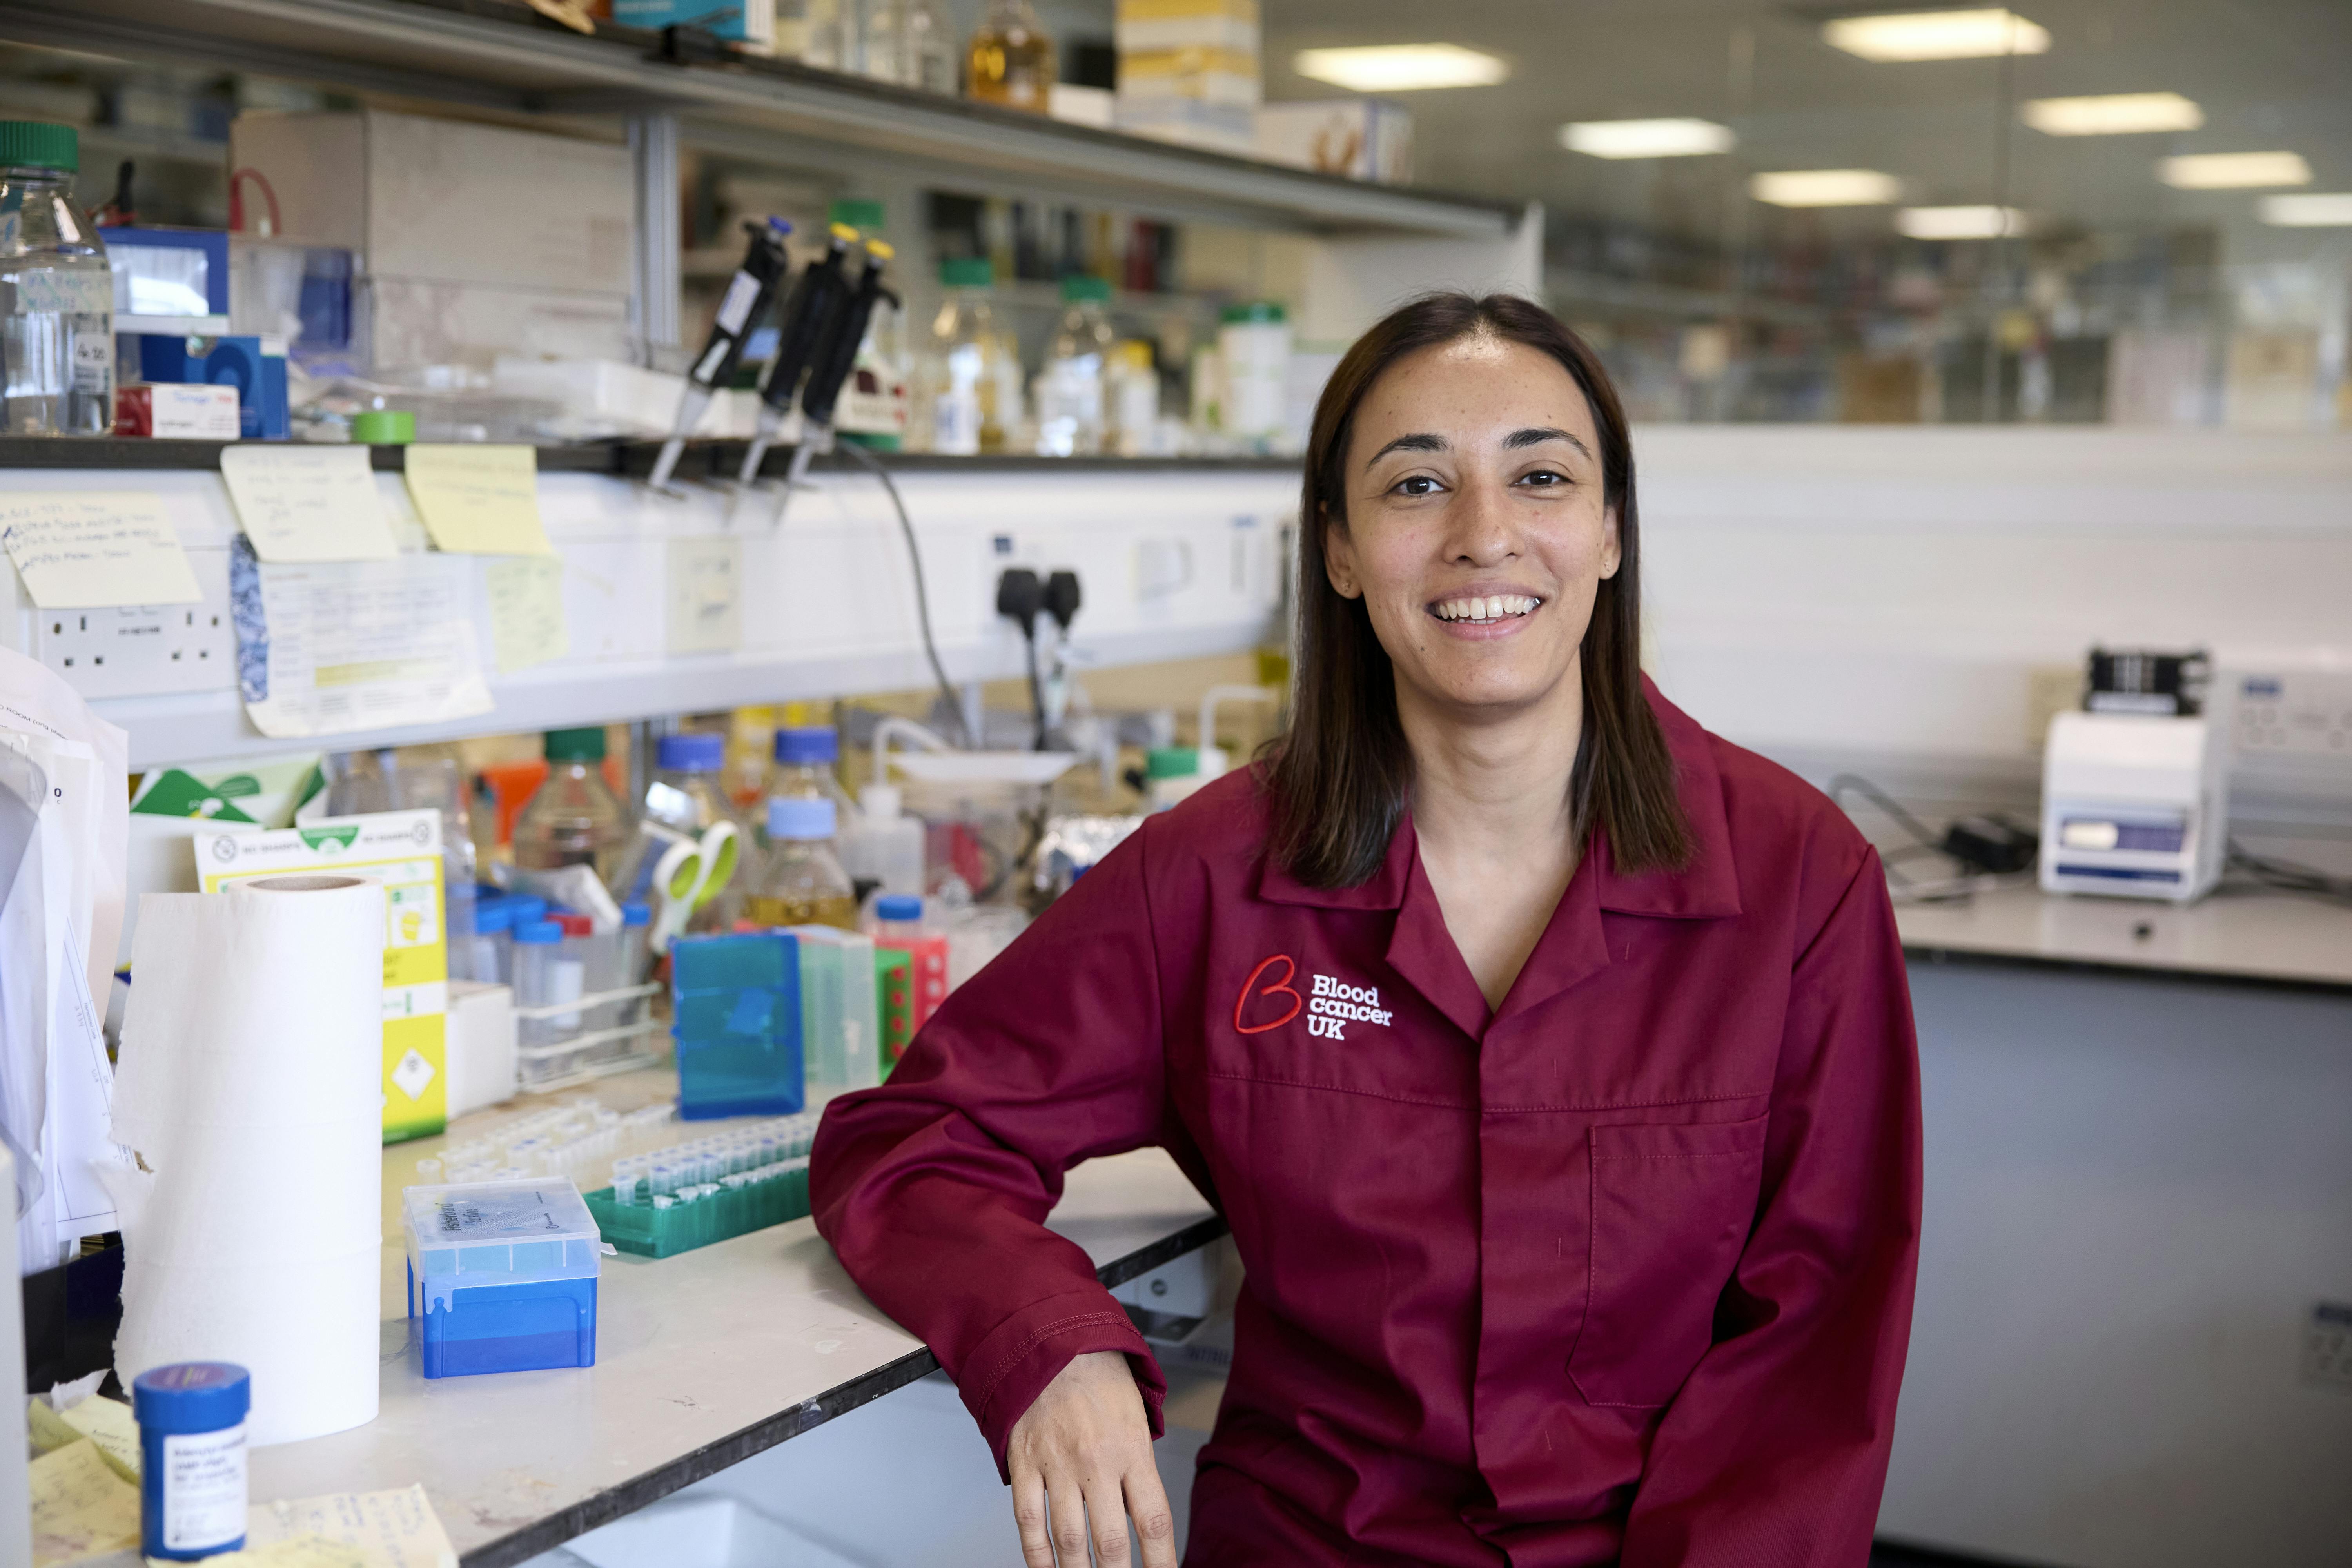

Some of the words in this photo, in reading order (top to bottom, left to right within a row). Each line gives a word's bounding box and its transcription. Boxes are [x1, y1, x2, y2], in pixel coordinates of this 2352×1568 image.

[6, 707, 31, 722] ROOM
[1311, 974, 1380, 1007] Blood
[1310, 997, 1393, 1027] cancer
[1307, 1014, 1346, 1040] UK
